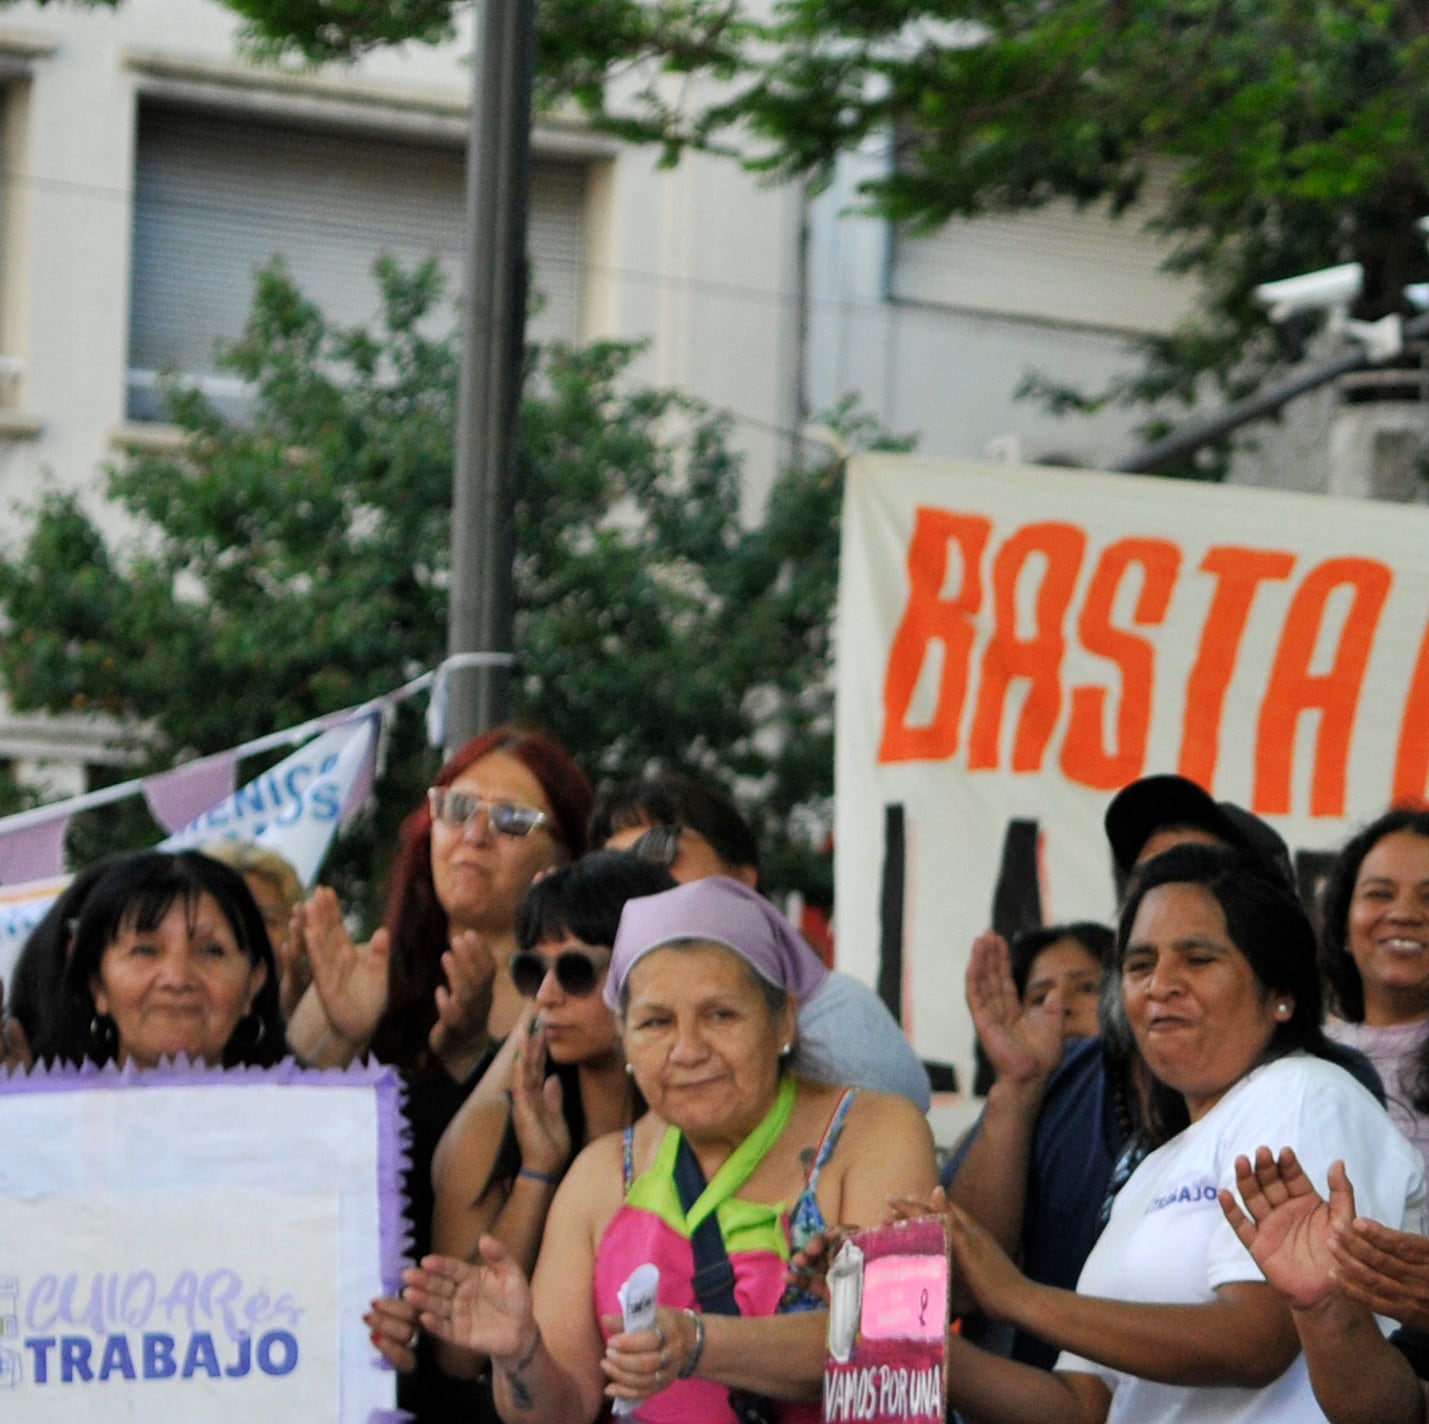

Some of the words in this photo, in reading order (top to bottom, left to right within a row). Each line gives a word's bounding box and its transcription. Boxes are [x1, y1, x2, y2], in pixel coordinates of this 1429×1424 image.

[877, 506, 1394, 820] BASTA
[25, 1267, 245, 1341] CUIDAR
[23, 1328, 300, 1385] TRABAJO
[823, 1365, 878, 1424] VAMOS
[879, 1363, 908, 1421] POR
[909, 1363, 942, 1418] UNA
